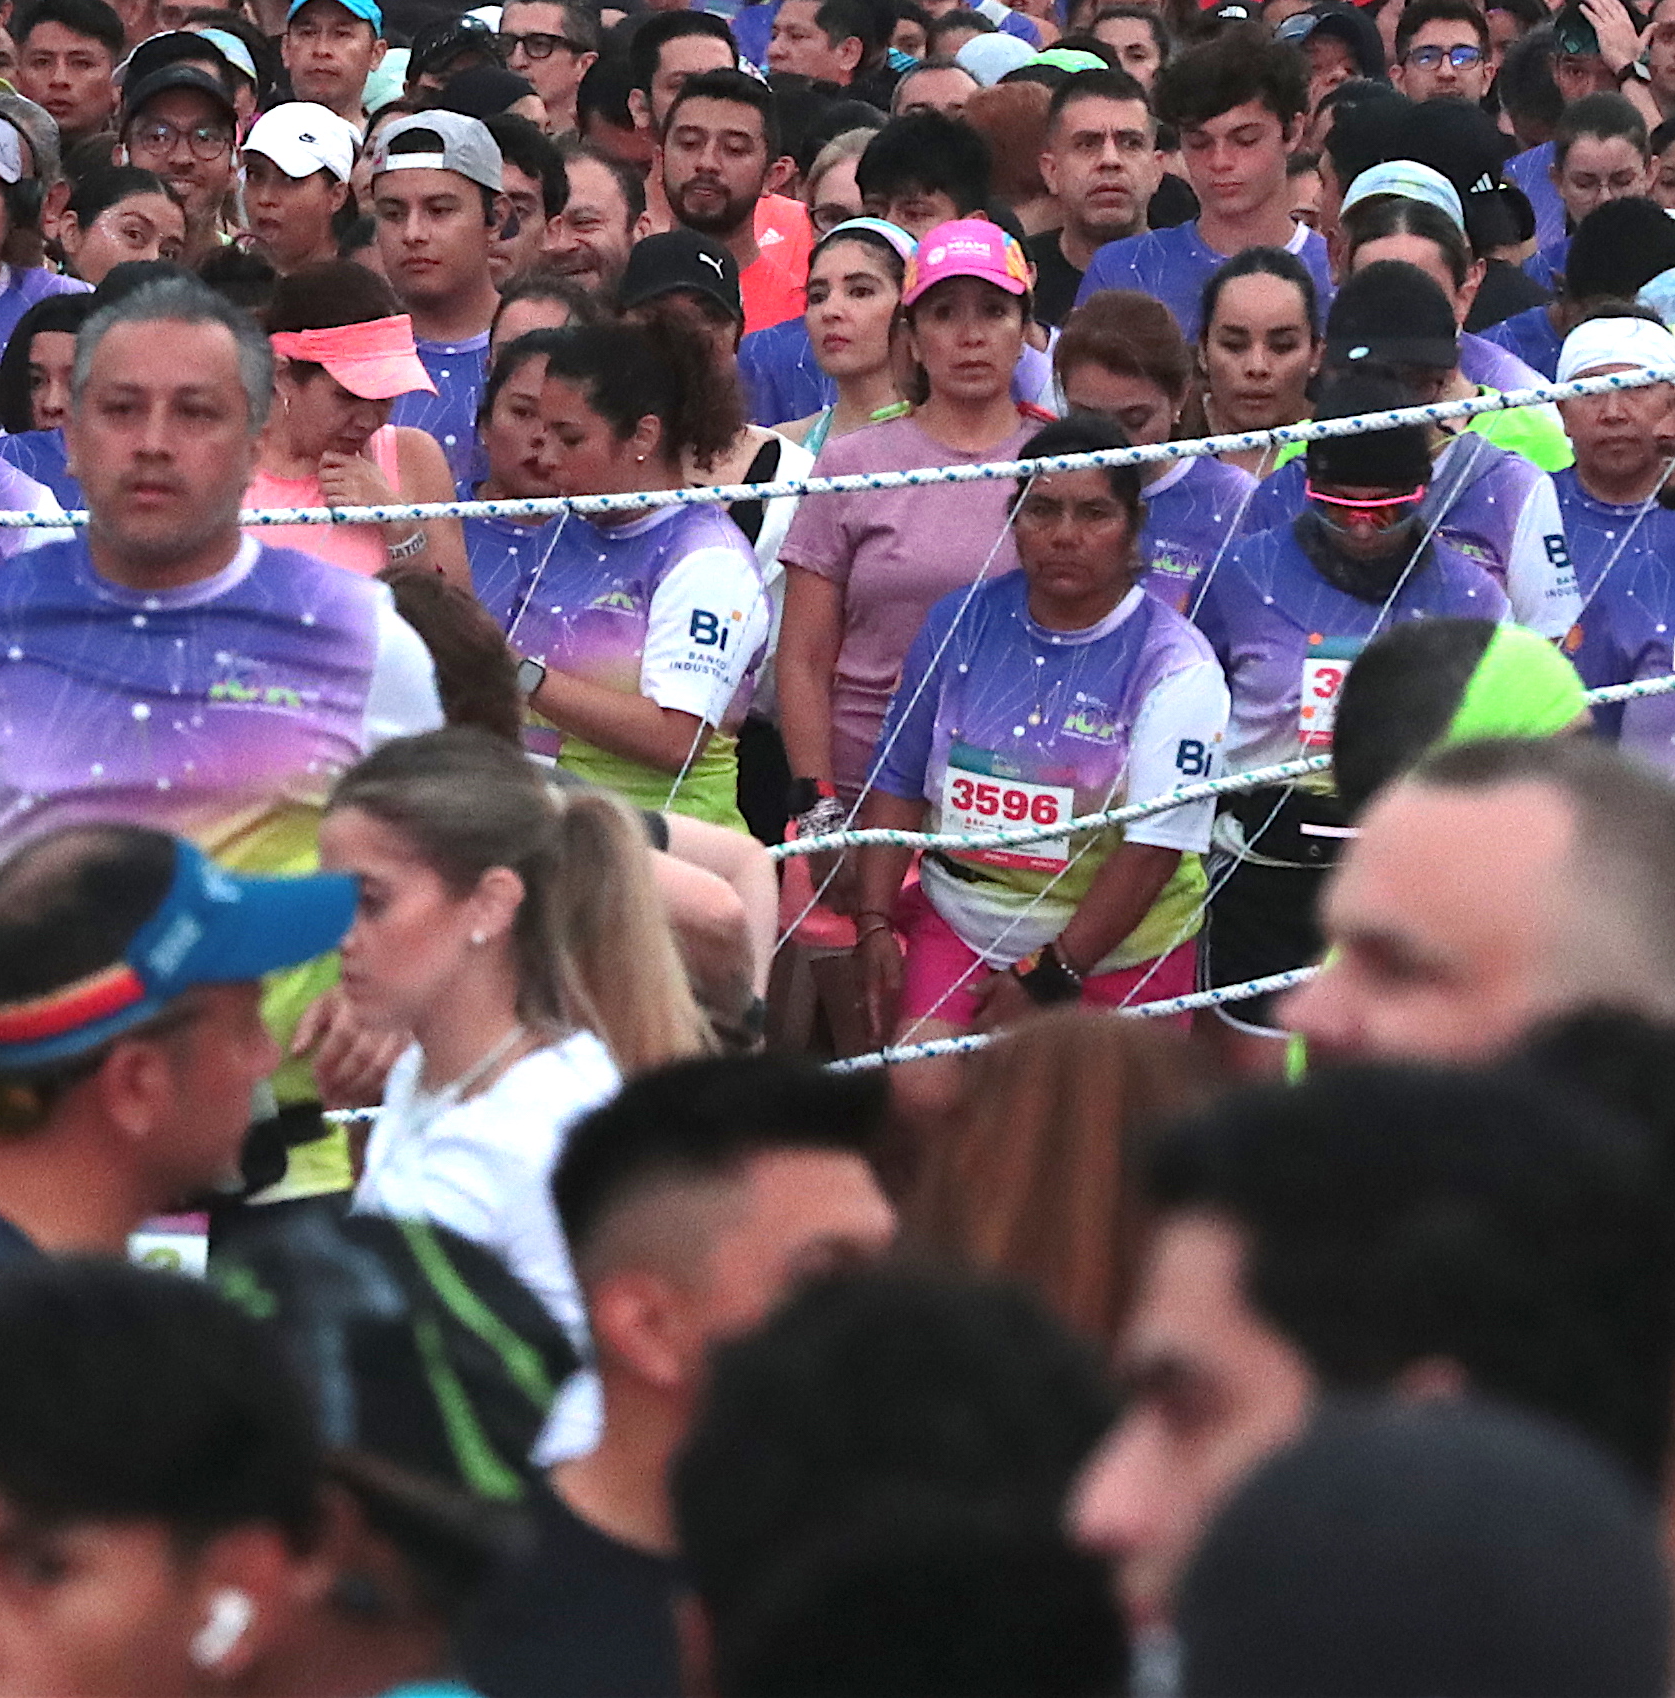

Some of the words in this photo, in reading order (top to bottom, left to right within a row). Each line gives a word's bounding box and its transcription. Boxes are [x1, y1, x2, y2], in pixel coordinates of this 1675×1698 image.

[1543, 534, 1573, 569] B
[689, 608, 732, 652] Bi
[1176, 737, 1218, 778] Bi
[951, 778, 1059, 825] 3596
